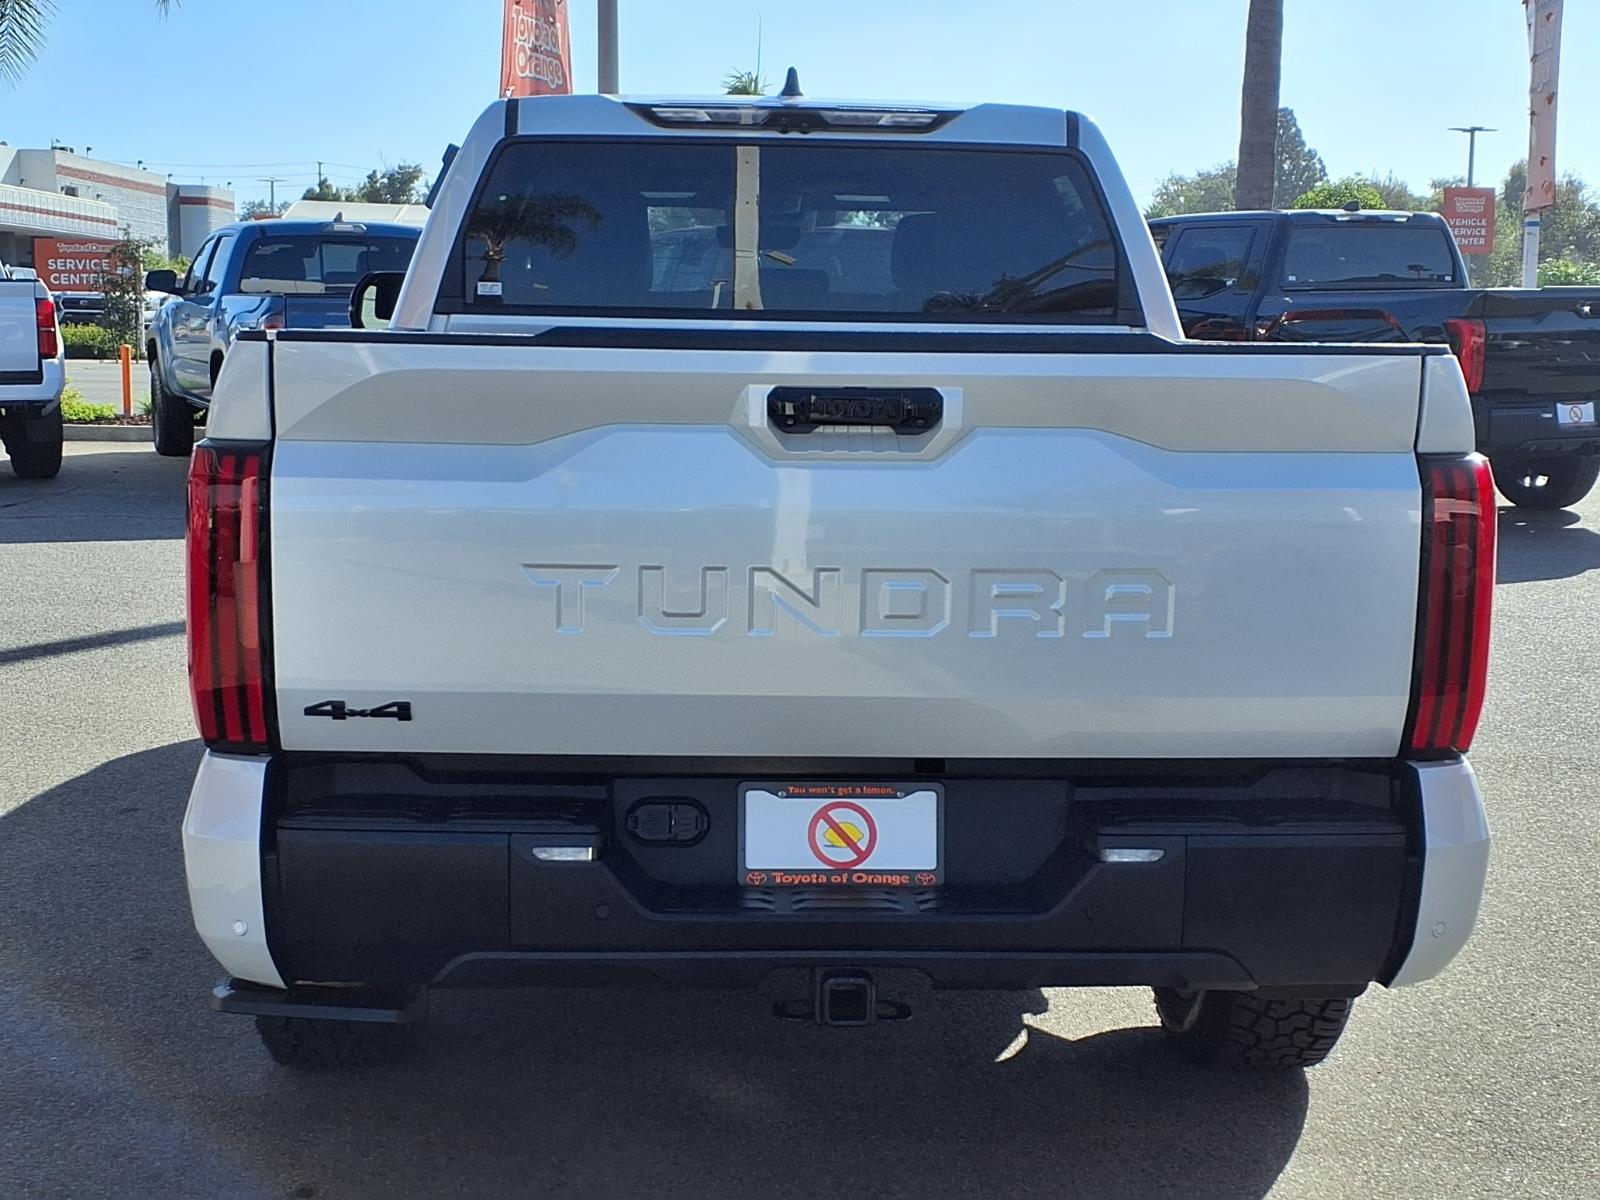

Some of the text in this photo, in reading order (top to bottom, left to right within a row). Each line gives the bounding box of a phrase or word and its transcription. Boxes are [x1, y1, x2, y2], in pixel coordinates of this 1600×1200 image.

[516, 42, 563, 89] Orange
[1450, 218, 1488, 226] VEHICLE
[1452, 228, 1487, 236] ERVICE
[1456, 237, 1486, 245] ENTER
[47, 258, 111, 270] SERVICE
[814, 398, 899, 417] TOYOTA
[521, 562, 1176, 638] TUNDRA
[788, 785, 806, 794] You
[808, 785, 835, 794] won't
[838, 786, 853, 796] get
[863, 785, 896, 795] lemon.
[771, 872, 911, 886] Toyota of Orange
